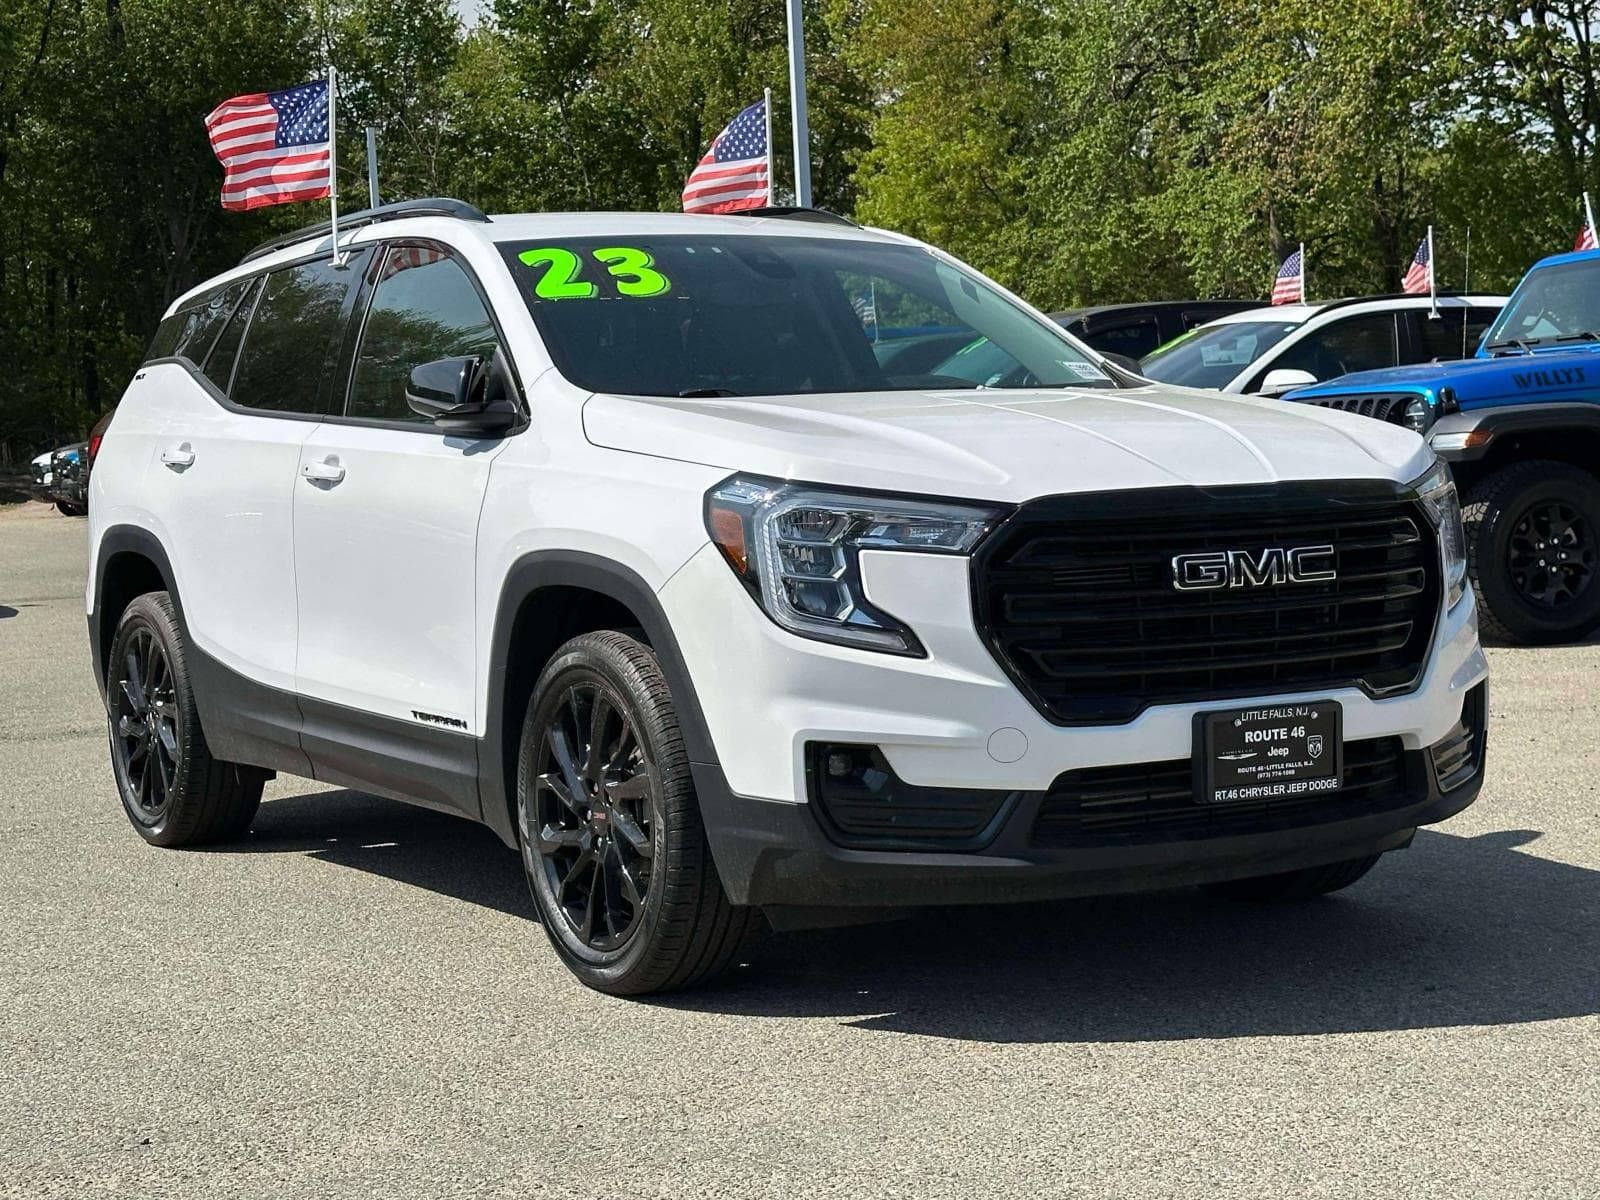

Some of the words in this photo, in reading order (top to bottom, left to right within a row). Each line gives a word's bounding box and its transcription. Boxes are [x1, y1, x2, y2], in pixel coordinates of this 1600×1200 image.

[518, 247, 672, 300] 23
[1512, 367, 1584, 388] WILLYS
[1172, 544, 1337, 590] GMC
[1241, 710, 1268, 722] LITTLE
[1269, 708, 1294, 719] FALLS,
[1244, 727, 1288, 743] ROUTE
[1290, 726, 1306, 738] 46
[1267, 746, 1289, 757] Jeep
[1237, 766, 1257, 774] ROUTE
[1239, 784, 1286, 798] CHRYSLER
[1286, 782, 1308, 794] JEEP
[1308, 778, 1338, 791] DODGE
